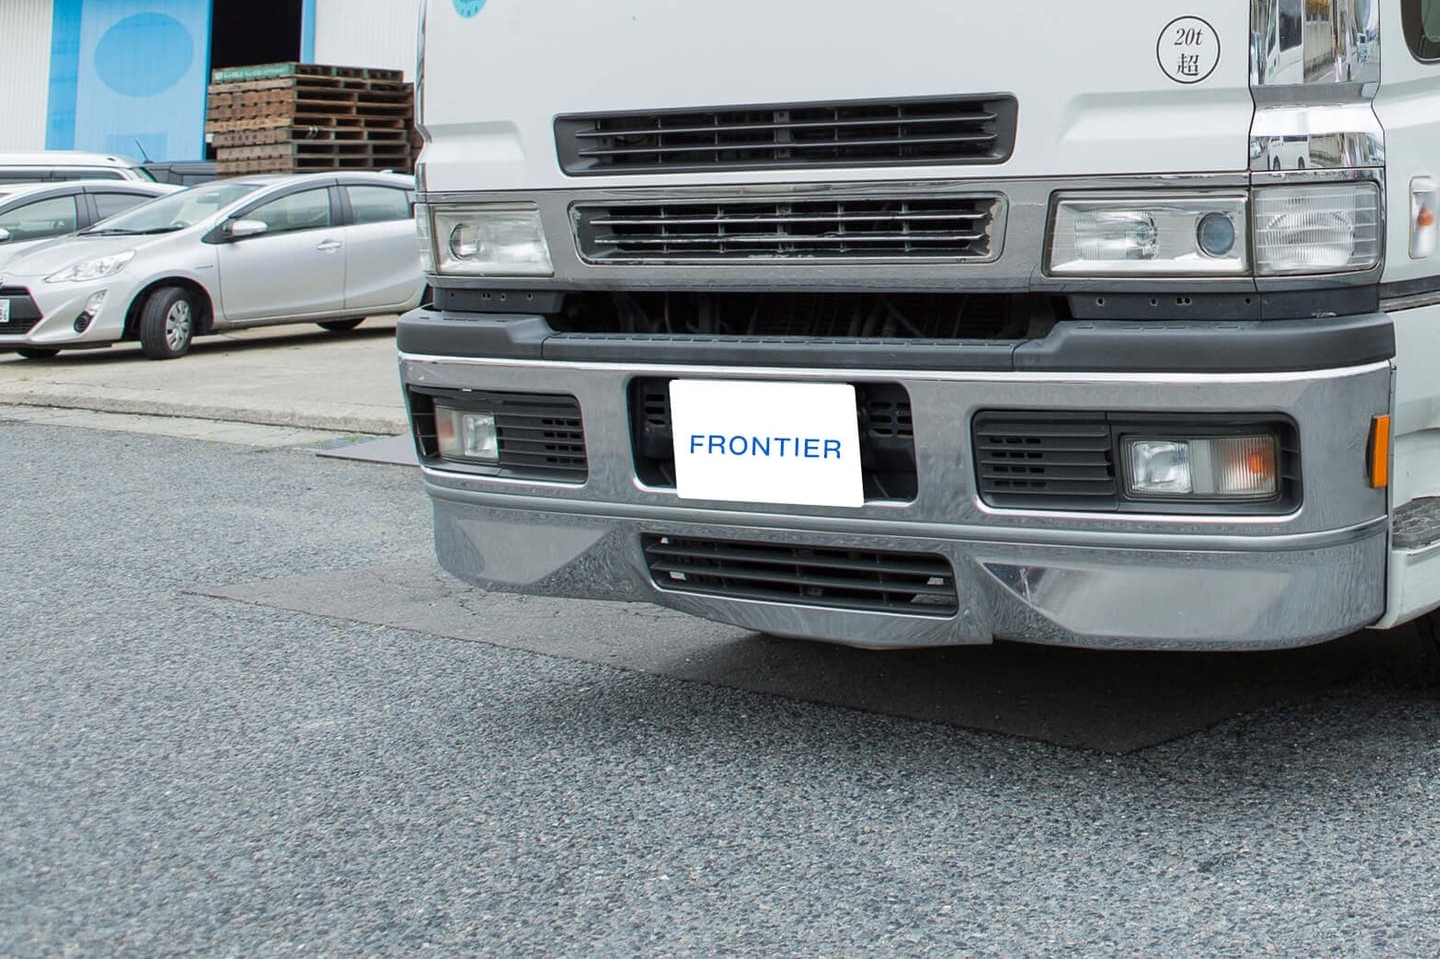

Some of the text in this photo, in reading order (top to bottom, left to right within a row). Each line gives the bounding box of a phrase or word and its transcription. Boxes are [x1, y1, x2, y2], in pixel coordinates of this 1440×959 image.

[1174, 27, 1204, 46] 20t
[1176, 53, 1200, 76] 超
[689, 434, 842, 459] FRONTIER
